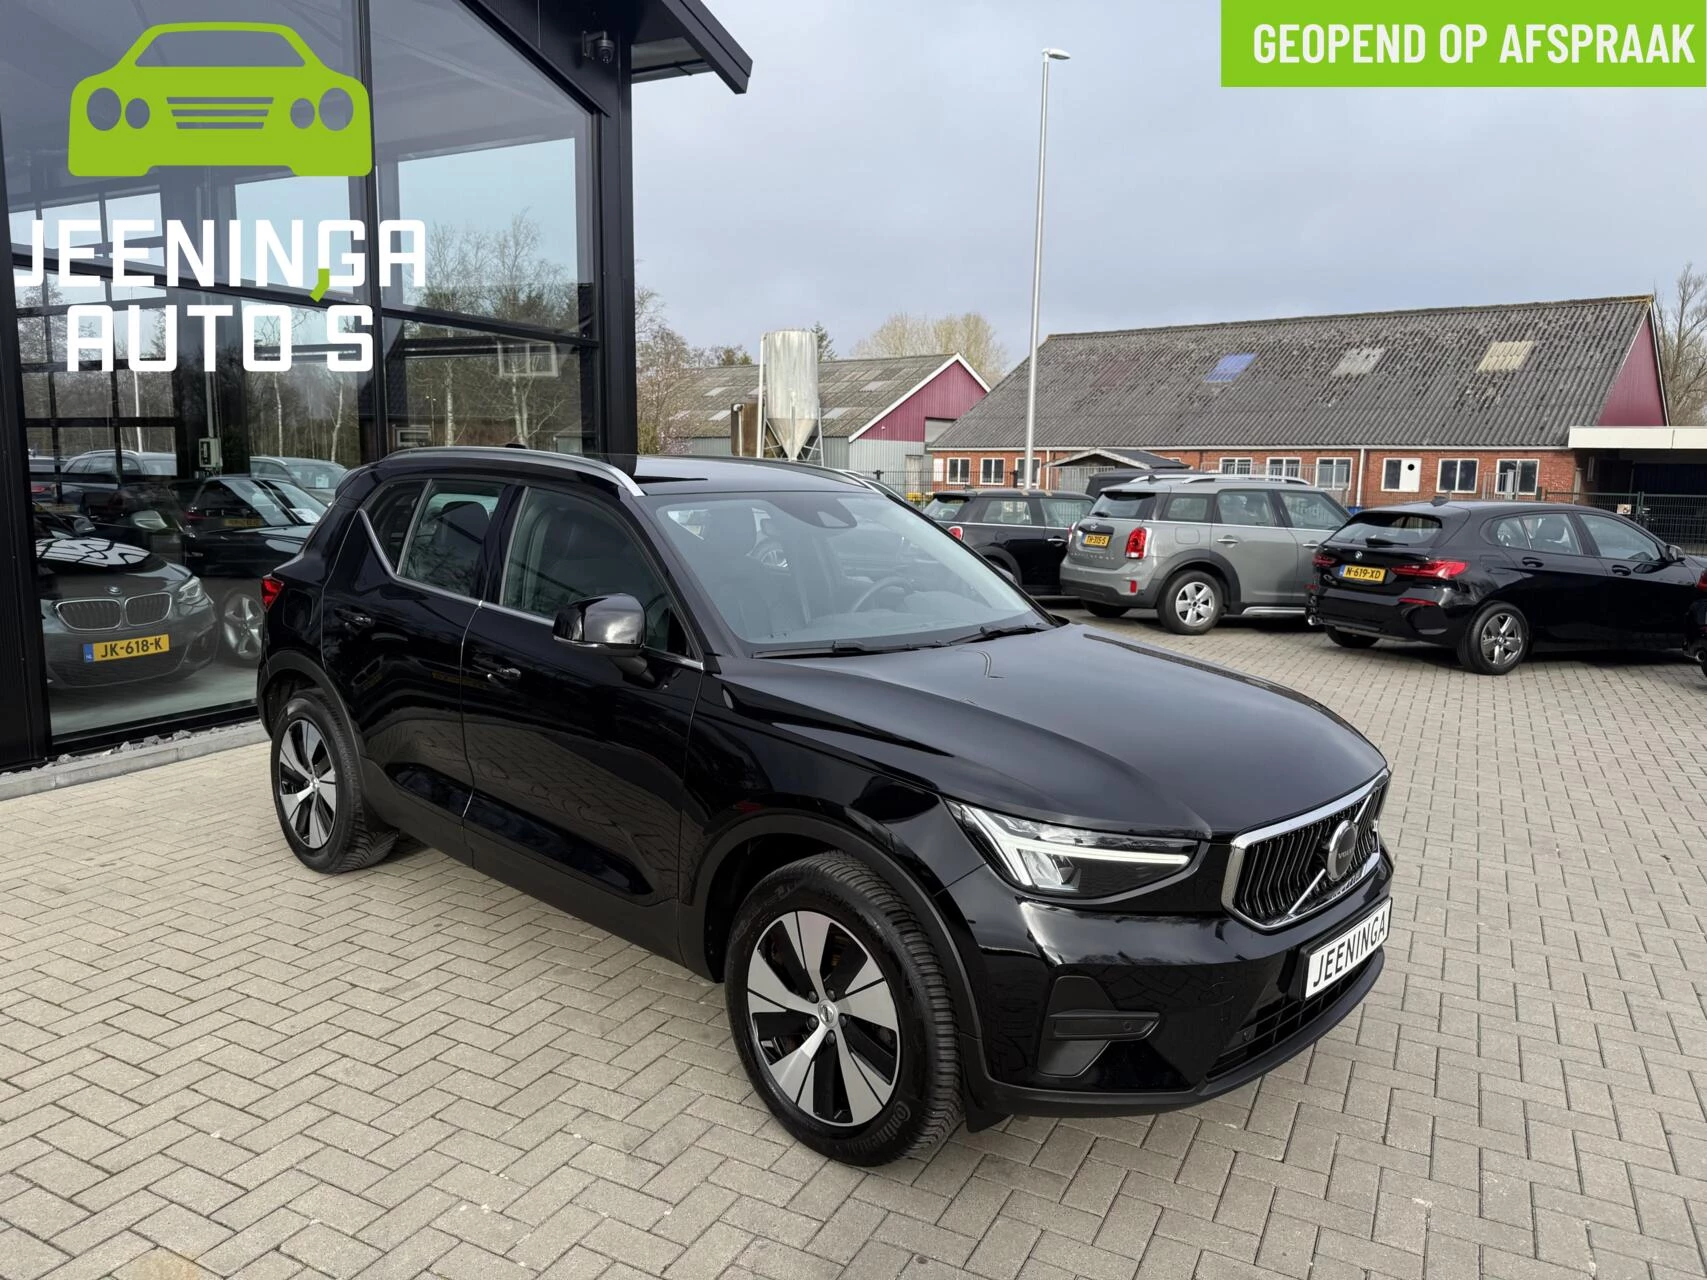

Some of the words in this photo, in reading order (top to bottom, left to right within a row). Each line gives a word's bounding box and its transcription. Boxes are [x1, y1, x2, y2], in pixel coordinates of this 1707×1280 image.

[1345, 567, 1382, 579] N-619-XD
[101, 637, 163, 658] JK-618-K
[1313, 910, 1385, 988] JEENINGA
